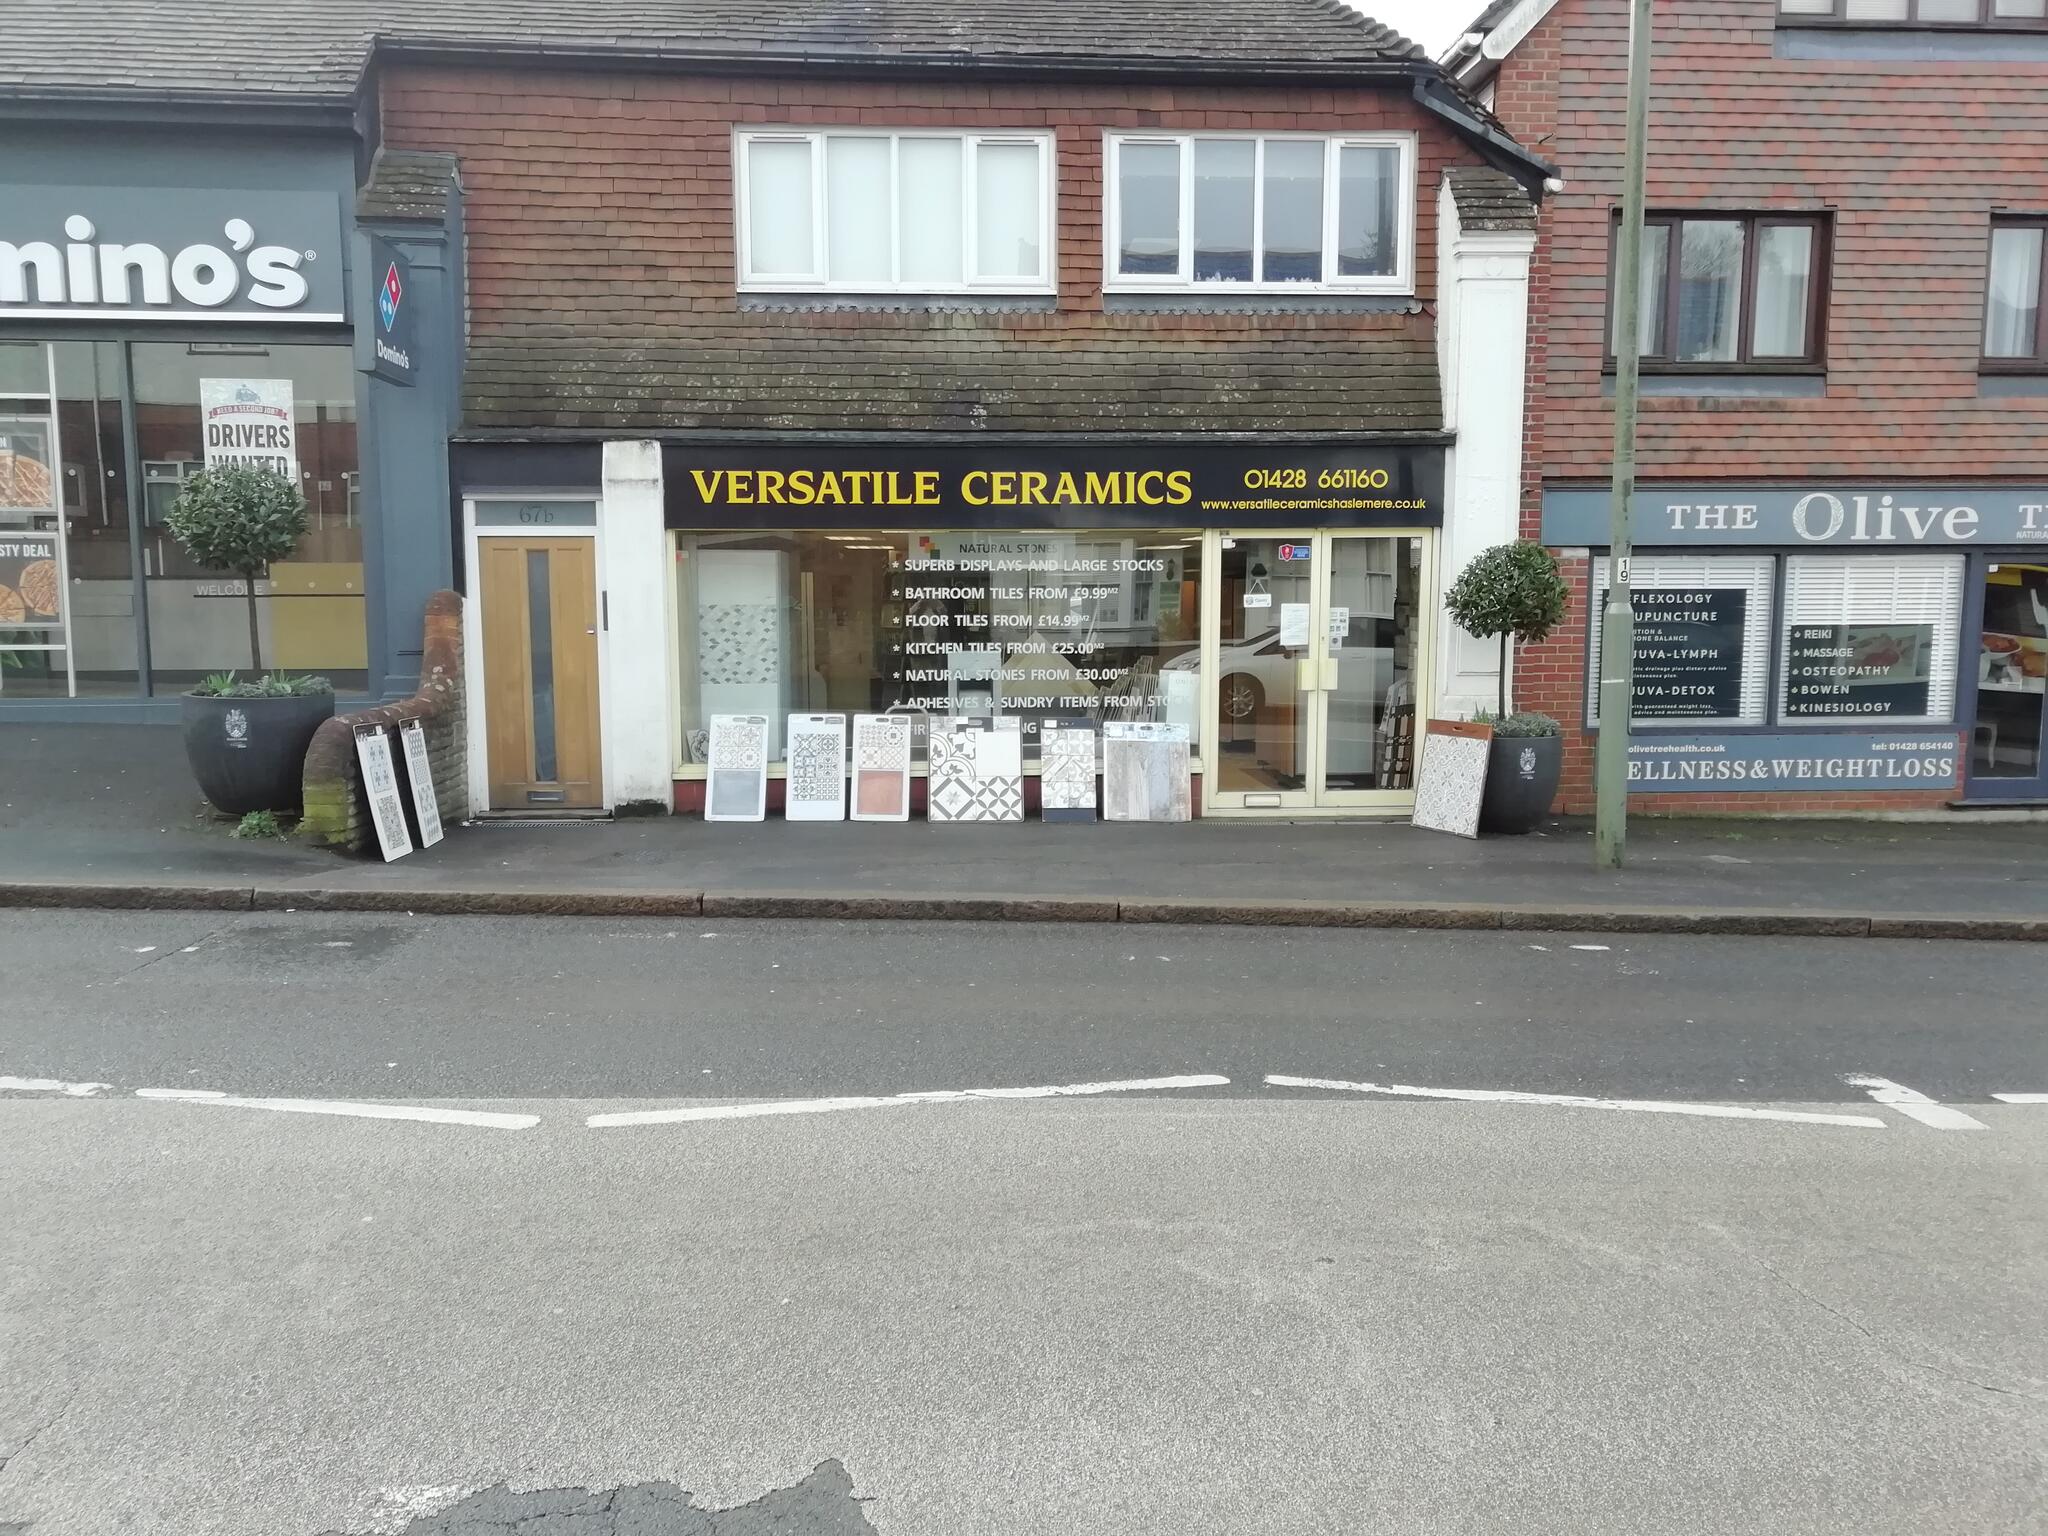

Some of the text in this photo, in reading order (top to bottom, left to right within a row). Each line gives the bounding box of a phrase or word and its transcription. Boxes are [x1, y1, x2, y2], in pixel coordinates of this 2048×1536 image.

[377, 338, 410, 369] Domino's
[208, 424, 290, 448] DRIVERS
[1244, 469, 1389, 489] 01428 661160
[690, 470, 1192, 505] VERSATILE CERAMICS
[1201, 498, 1426, 510] www.versatileceramicshaslemere.co.uk
[1667, 492, 2048, 541] THE Olive T
[23, 544, 51, 557] DEAL
[959, 543, 1012, 554] NATURAL
[905, 559, 1164, 571] SUPERB DISPLAYS AND LARGE STOCKS
[196, 585, 265, 596] WELCOE
[905, 587, 985, 600] BATHROOM
[989, 587, 1024, 600] TILES
[1028, 587, 1068, 600] FROM
[1629, 594, 1713, 604] FLEXOLOGY
[905, 614, 949, 627] FLOOR
[954, 614, 989, 627] TILES
[993, 614, 1033, 627] FROM
[1634, 611, 1718, 621] UPUNCTURE
[1804, 629, 1832, 639] REIKI
[906, 642, 964, 655] KITCHEN
[967, 642, 1002, 655] TILES
[1006, 642, 1046, 655] FROM
[1632, 649, 1719, 660] JUVA-LYMPH
[1803, 648, 1854, 657] MASSAGE
[905, 669, 971, 682] NATURAL
[974, 669, 1026, 681] STONES
[1030, 669, 1070, 681] FROM
[1802, 666, 1890, 676] OSTEOPATHY
[1631, 686, 1716, 696] JUVA-DETOX
[1801, 685, 1850, 695] BOWEN
[906, 697, 978, 709] ADHESIVES
[984, 697, 995, 708] &
[1001, 696, 1055, 709] SUNDRY
[1060, 696, 1099, 708] ITEMS
[1103, 696, 1143, 708] FROM
[1800, 702, 1891, 713] KINESIOLOGY
[1919, 742, 1953, 750] 654140
